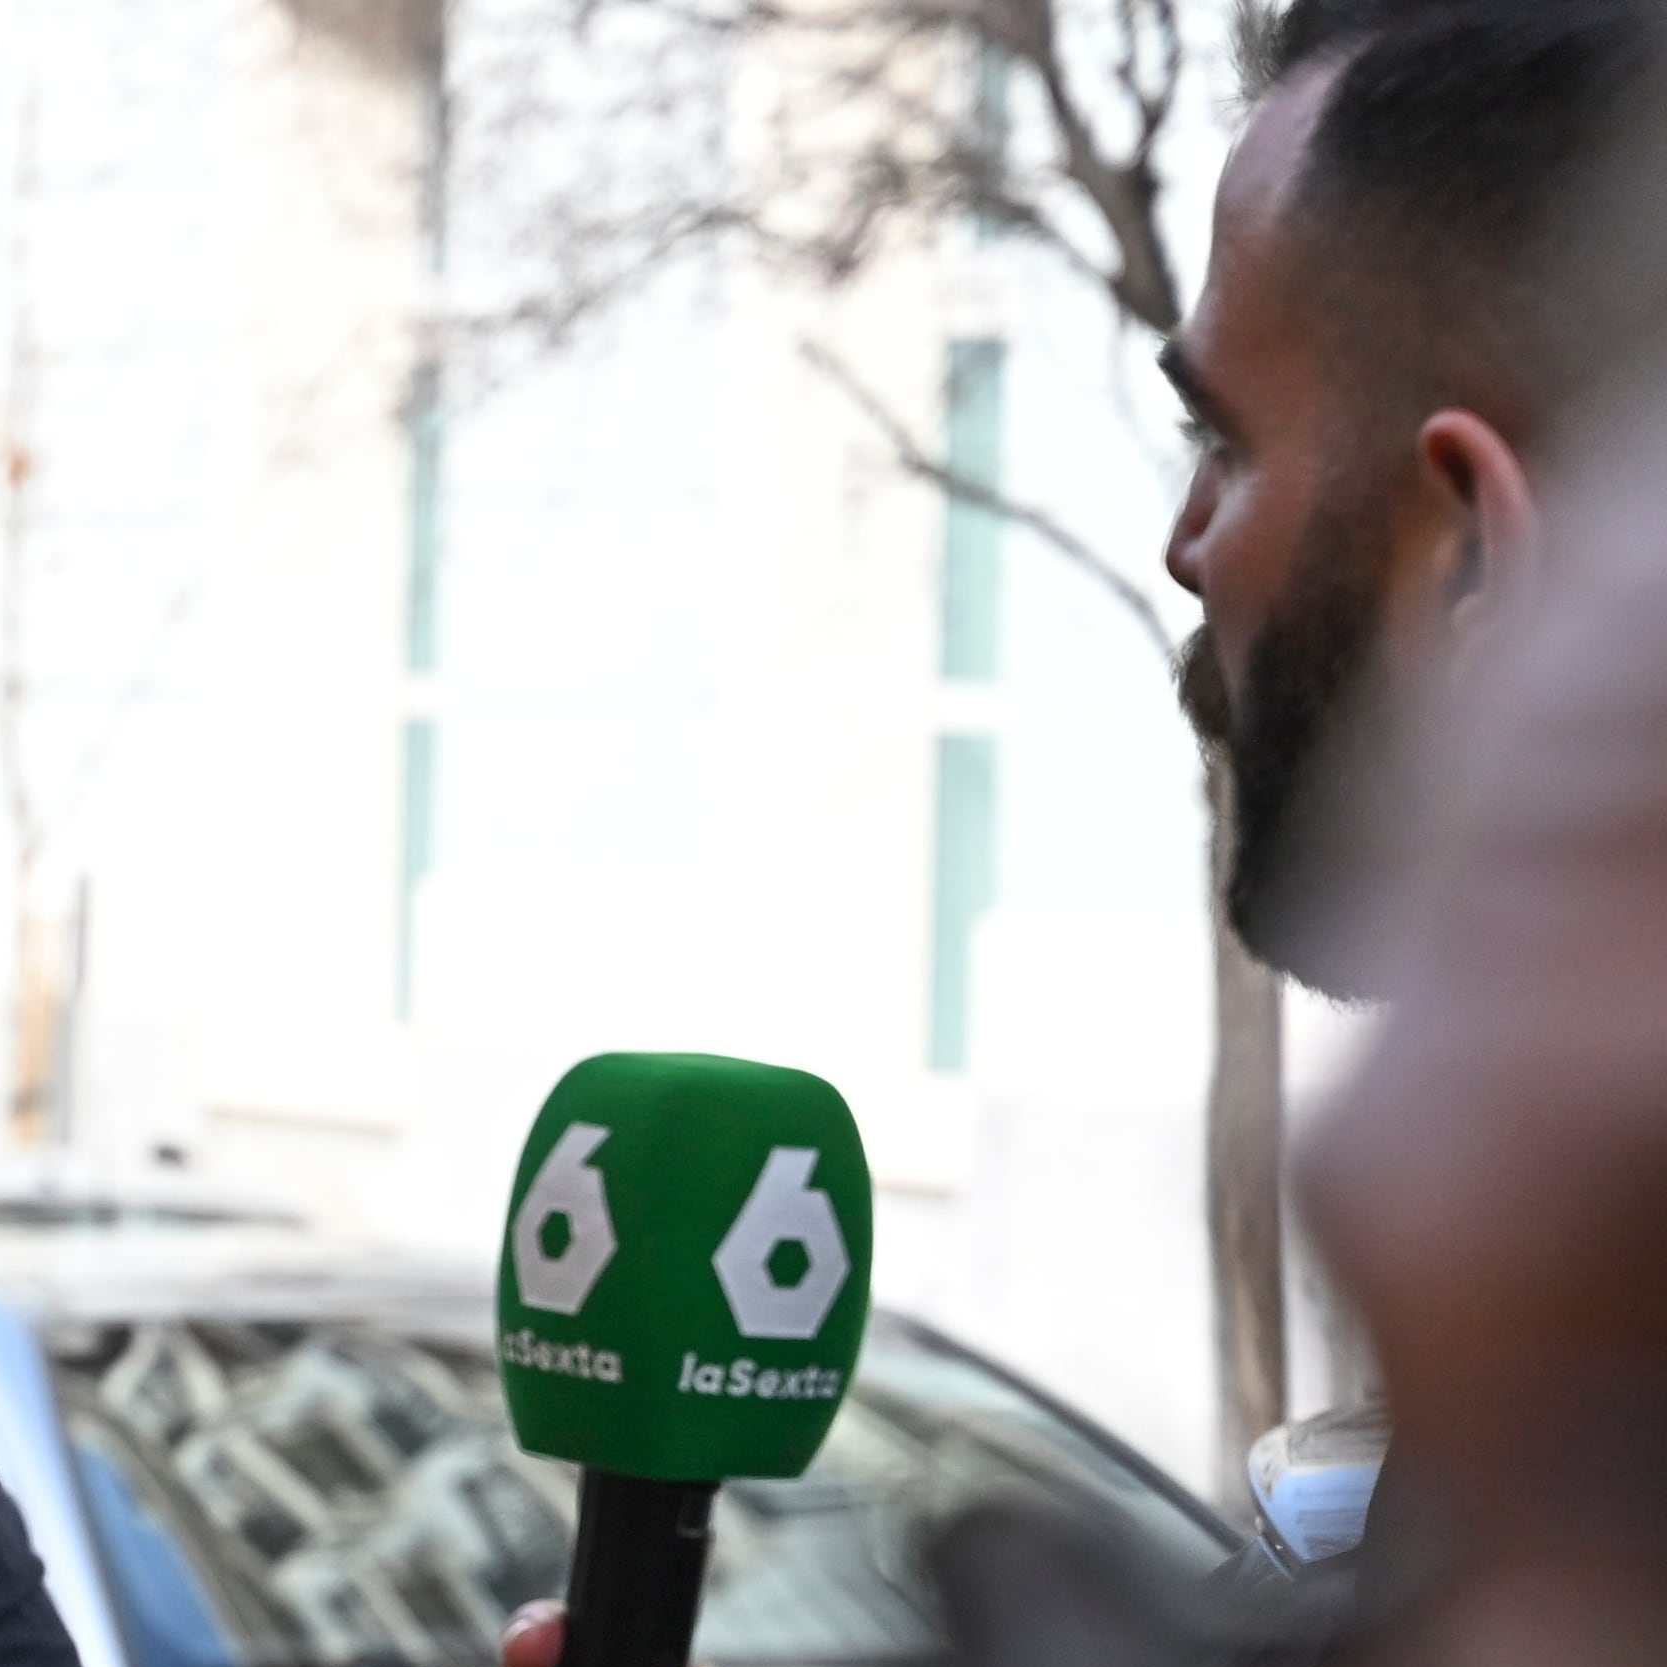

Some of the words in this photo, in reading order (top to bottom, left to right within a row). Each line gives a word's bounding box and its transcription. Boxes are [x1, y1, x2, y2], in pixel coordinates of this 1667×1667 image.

[512, 1121, 618, 1315] 6
[711, 1145, 851, 1340] 6
[678, 1352, 841, 1399] laSexta
